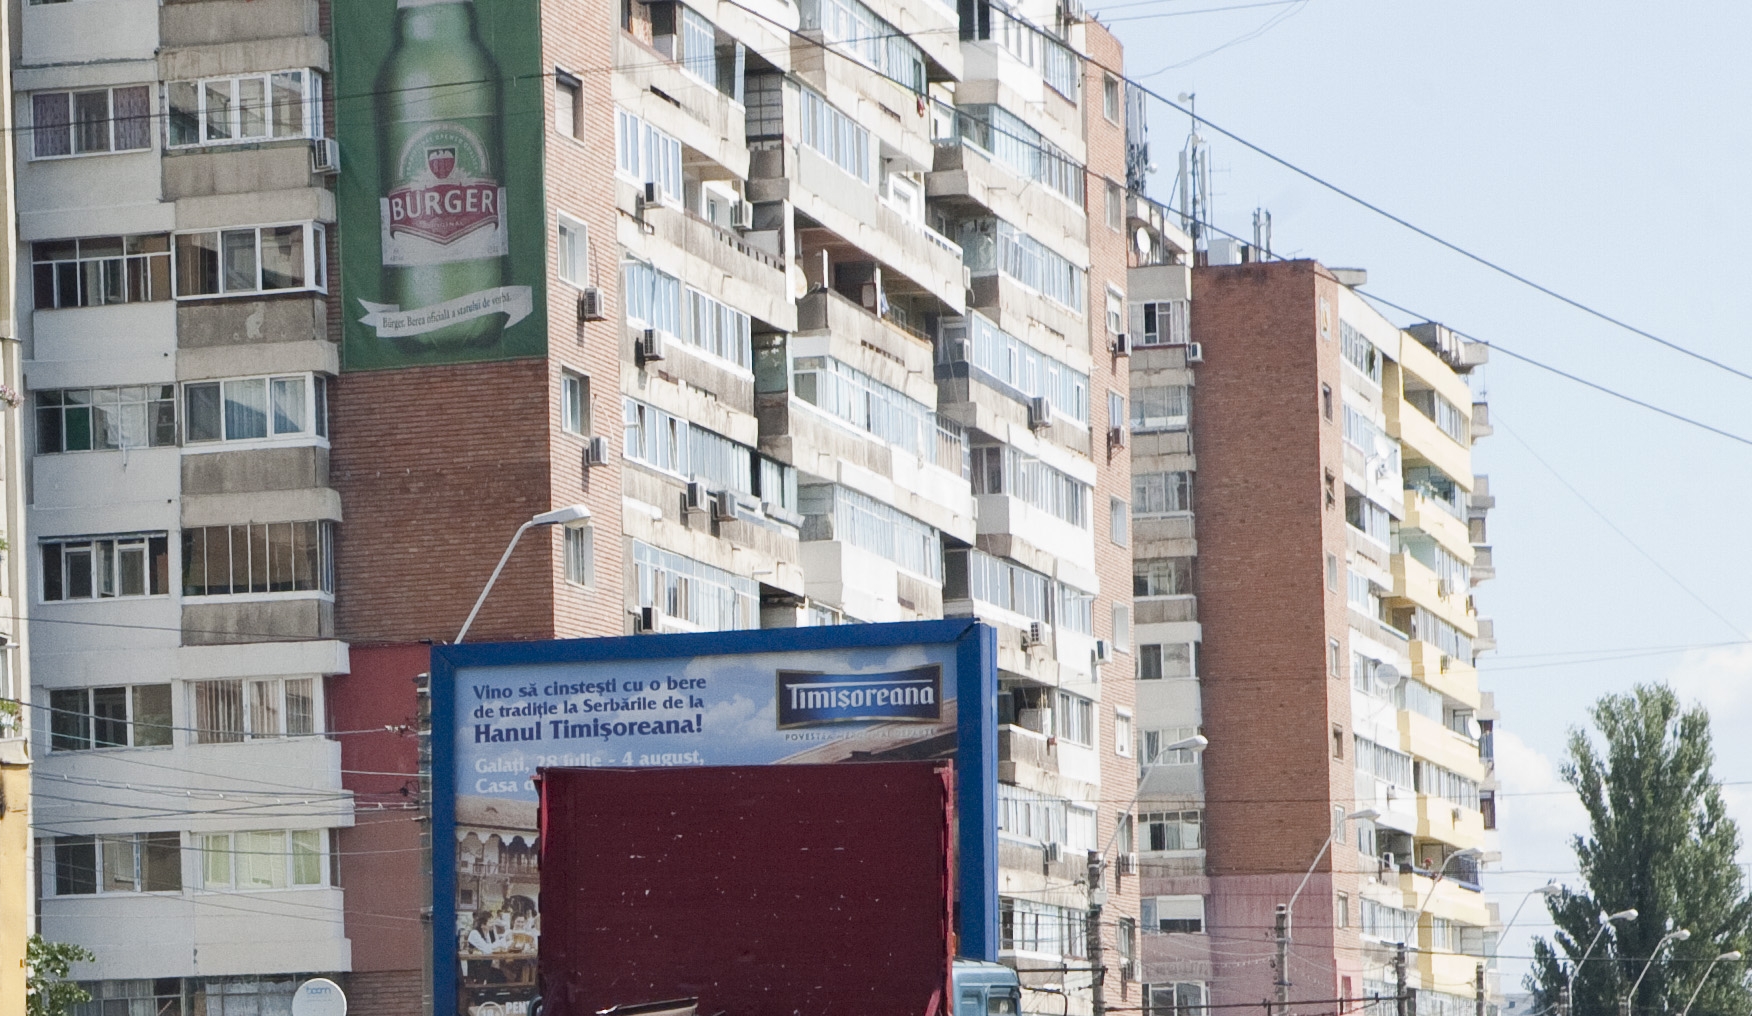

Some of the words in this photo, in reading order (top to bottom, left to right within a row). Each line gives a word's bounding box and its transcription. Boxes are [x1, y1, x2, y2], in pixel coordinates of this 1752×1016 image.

[473, 685, 513, 699] Vino
[519, 683, 538, 698] să
[623, 680, 643, 692] cu
[650, 680, 661, 692] o
[667, 675, 707, 690] bere
[473, 705, 494, 718] de
[563, 699, 578, 714] la
[583, 696, 657, 713] Serbările
[662, 695, 684, 709] de
[689, 694, 704, 709] la
[474, 721, 542, 744] Hanul
[621, 751, 633, 766] 4
[475, 778, 518, 794] Casa
